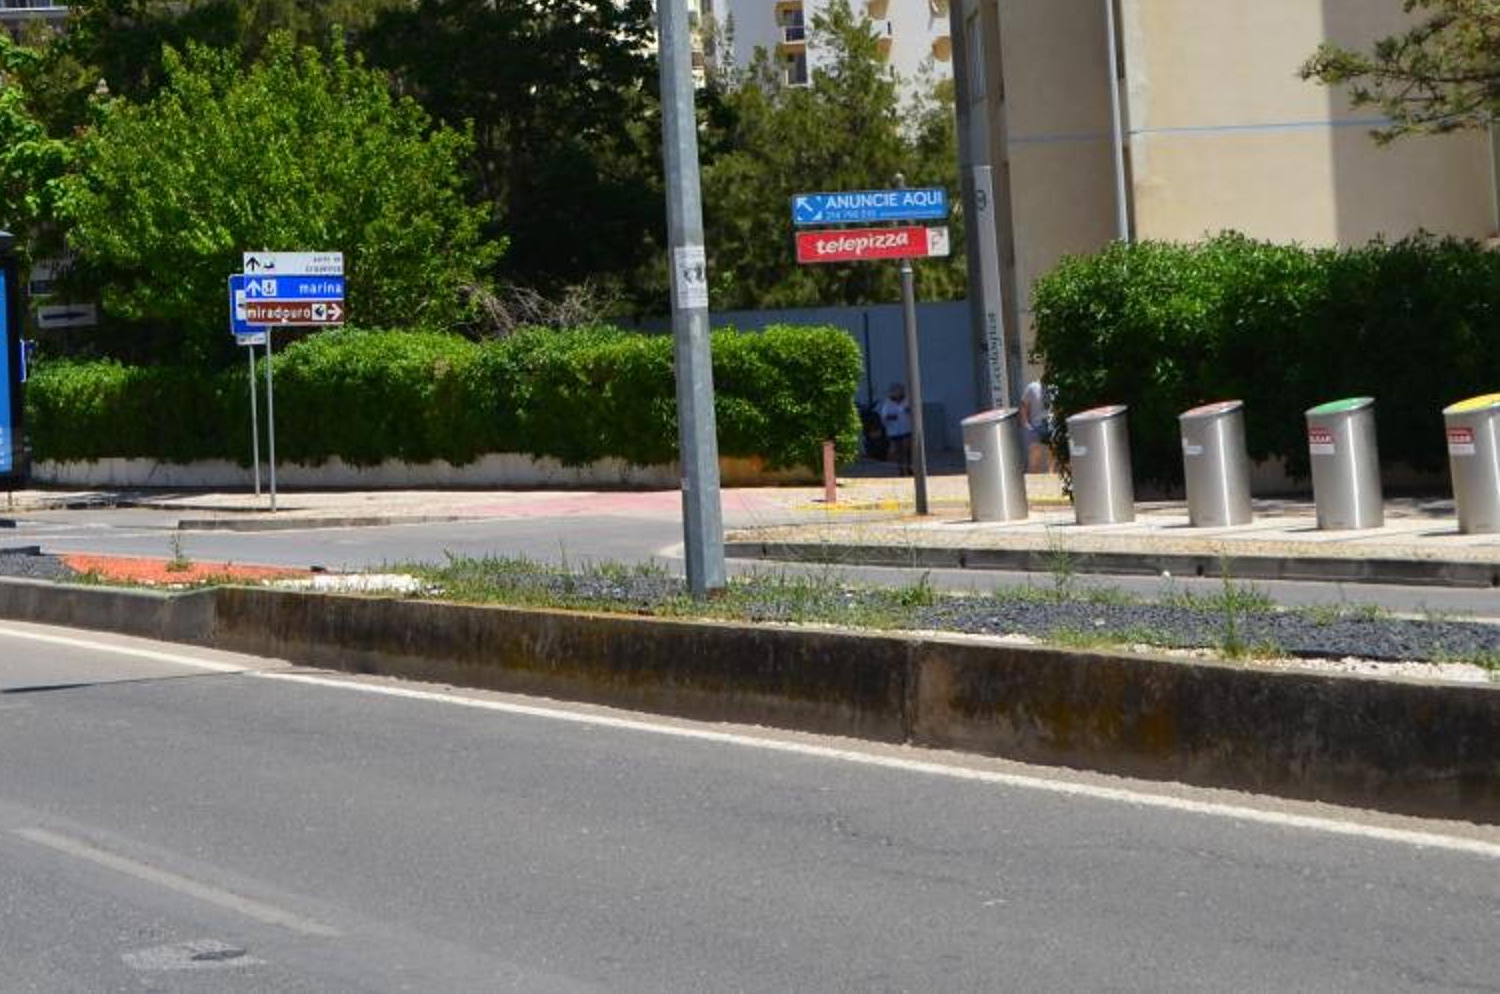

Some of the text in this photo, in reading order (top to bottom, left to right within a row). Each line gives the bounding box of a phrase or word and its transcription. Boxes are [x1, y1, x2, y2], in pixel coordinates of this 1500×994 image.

[825, 190, 942, 210] ANUNCIE AQUI
[816, 231, 909, 255] telepizza
[299, 281, 342, 295] marina
[247, 306, 311, 319] miradouro
